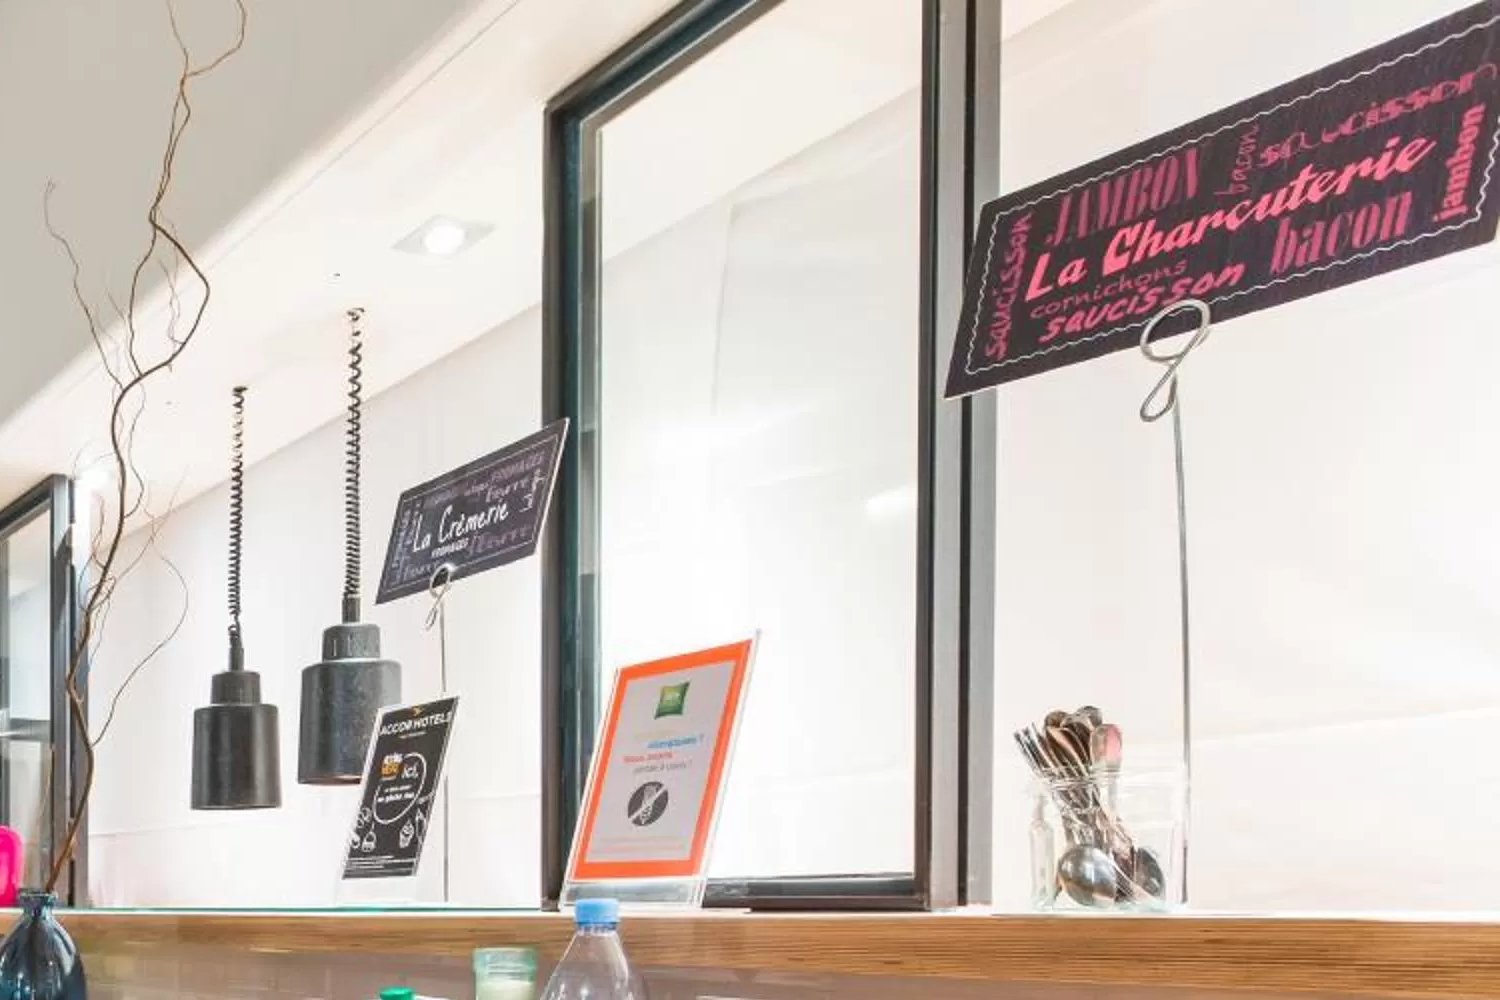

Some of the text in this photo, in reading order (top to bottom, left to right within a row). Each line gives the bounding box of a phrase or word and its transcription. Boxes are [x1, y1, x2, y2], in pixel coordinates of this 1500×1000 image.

[1433, 102, 1486, 222] jambon
[1024, 135, 1437, 303] La Charcuterie
[1269, 190, 1413, 276] bacon
[1030, 259, 1187, 319] cornichons
[411, 512, 431, 553] La
